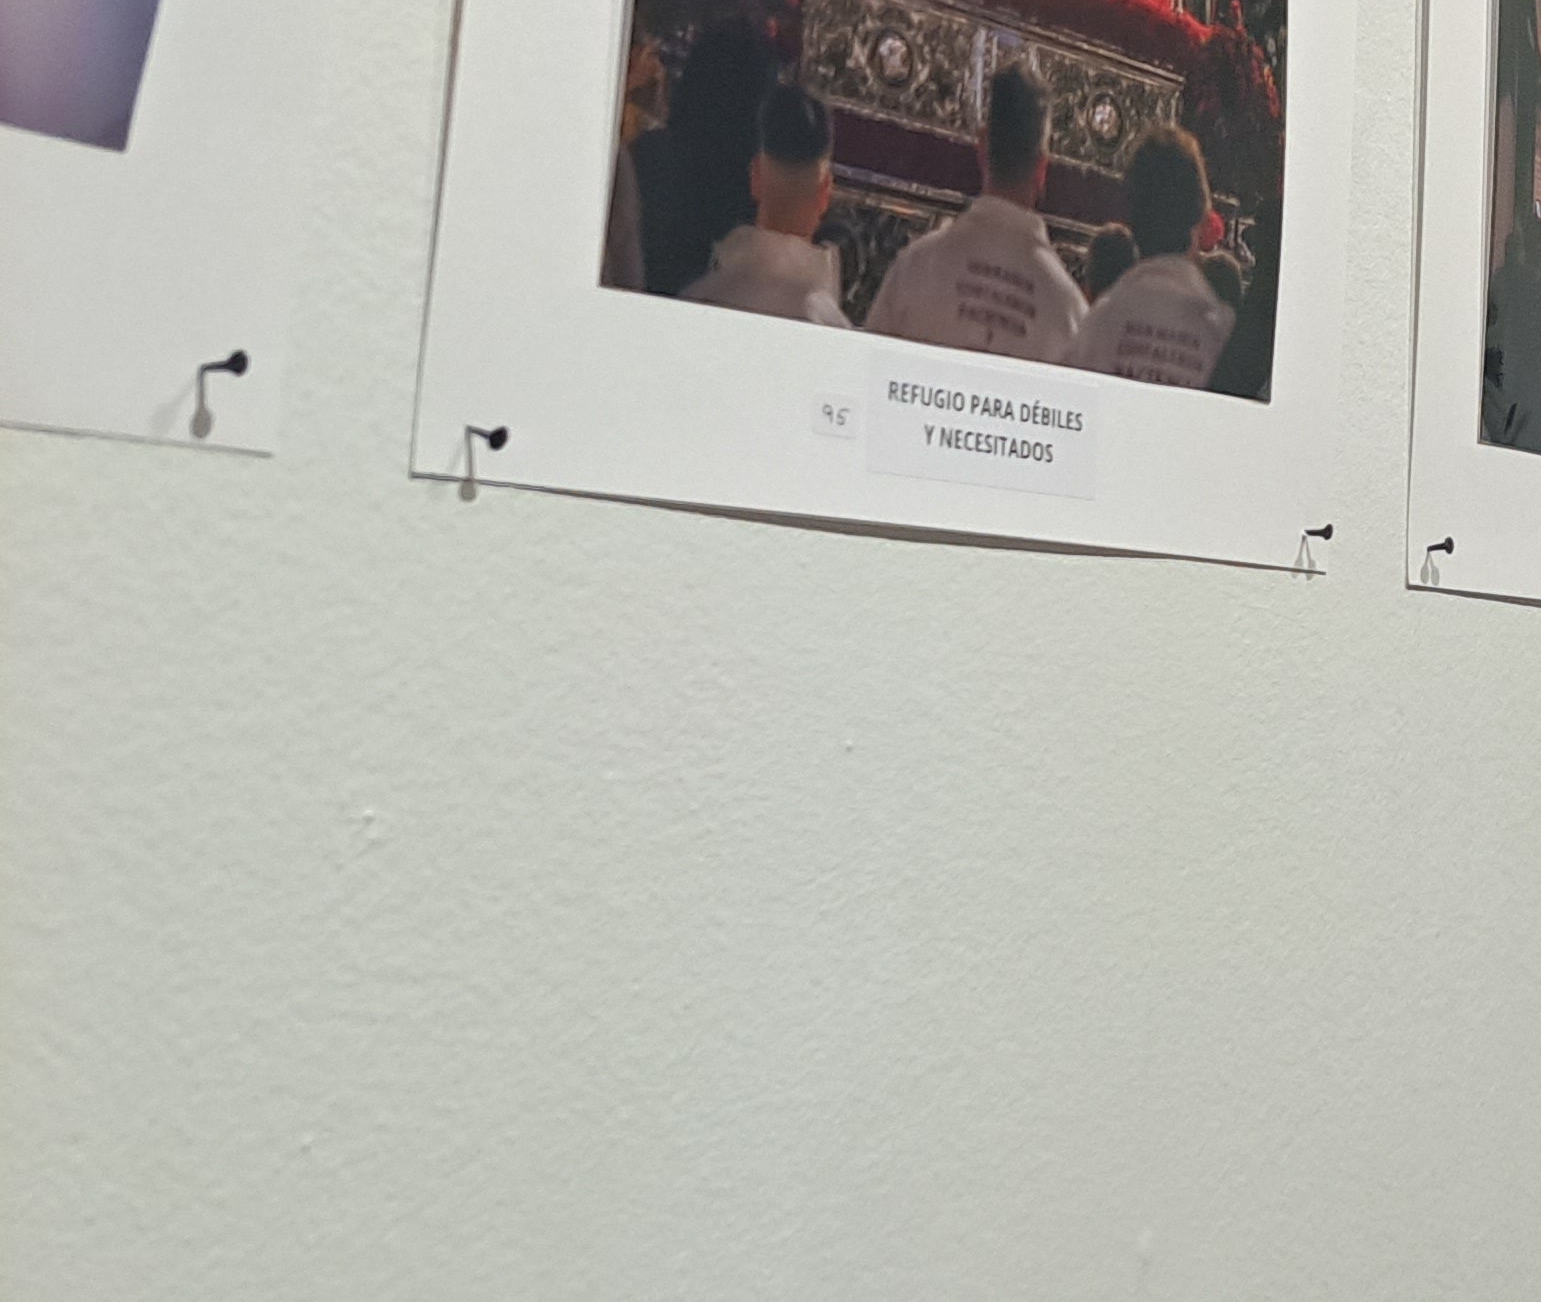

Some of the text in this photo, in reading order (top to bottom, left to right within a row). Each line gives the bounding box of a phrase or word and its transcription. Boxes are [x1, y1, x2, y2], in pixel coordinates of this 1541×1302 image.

[888, 380, 1083, 431] REFUGIO PARA DÉBILES
[924, 424, 1054, 463] Y NECESITADOS
